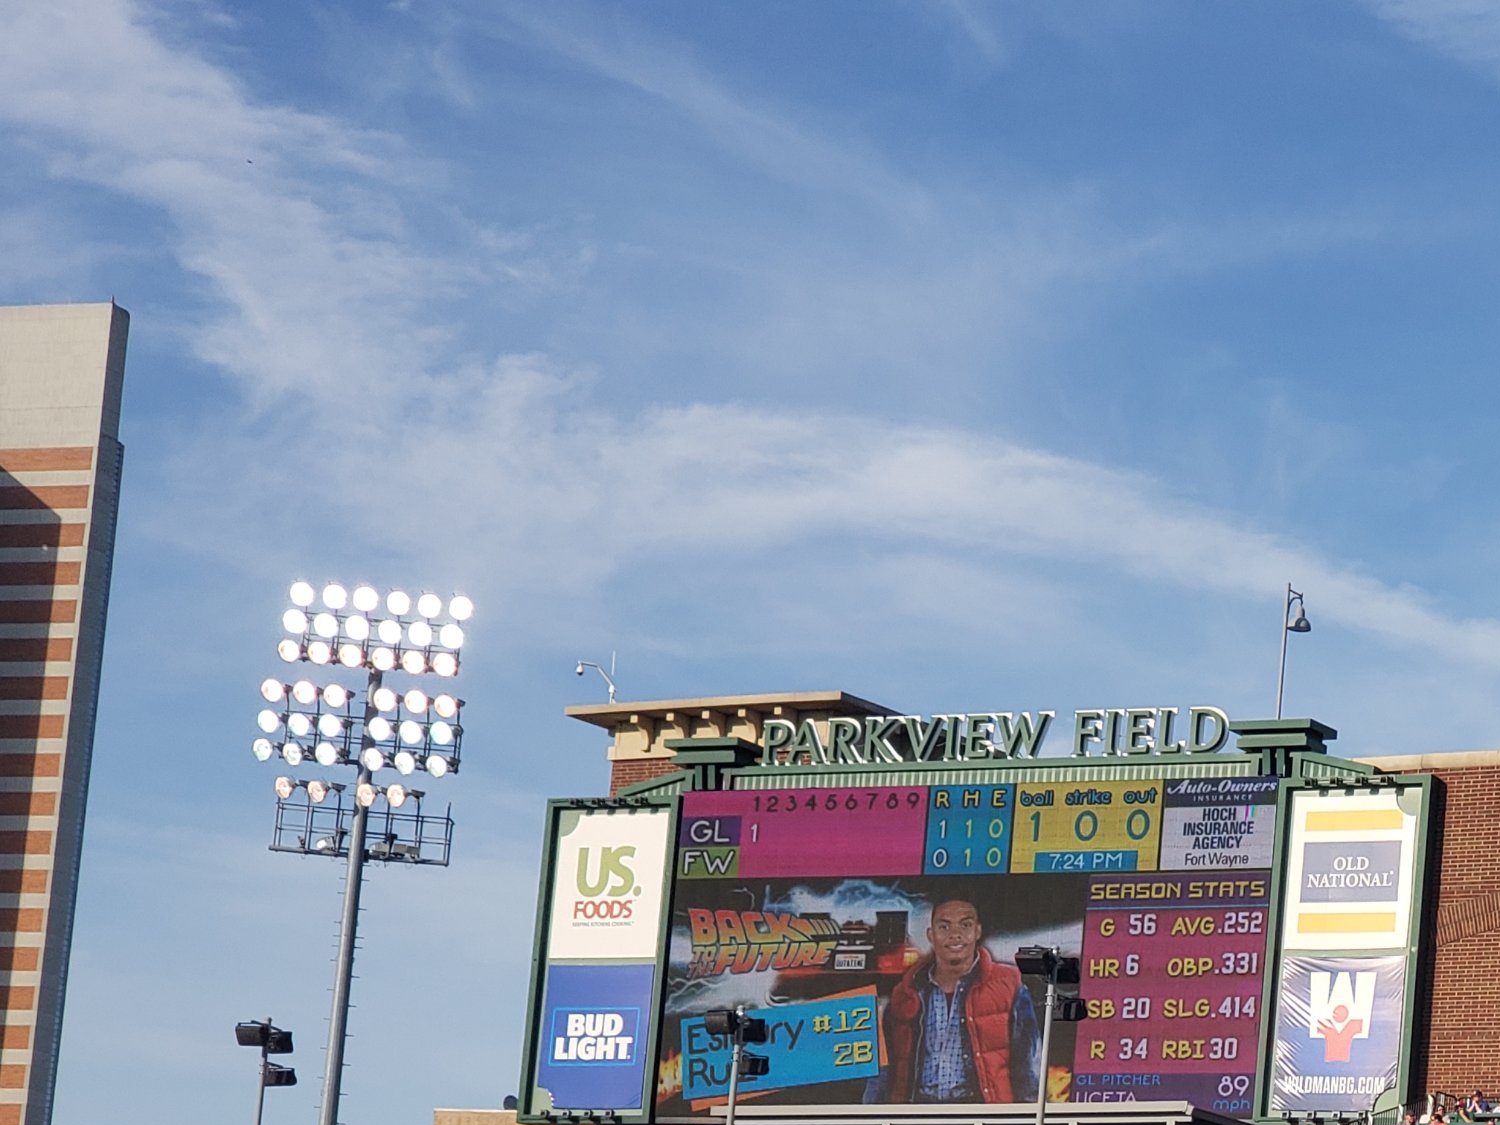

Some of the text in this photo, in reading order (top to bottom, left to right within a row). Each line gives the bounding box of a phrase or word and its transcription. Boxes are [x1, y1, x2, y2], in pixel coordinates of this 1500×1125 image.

[761, 705, 1230, 767] PARKVIEW FIELD
[1020, 787, 1158, 806] ball strike out
[1167, 778, 1277, 796] Auto-Owners
[936, 789, 1007, 808] R H E
[1030, 808, 1151, 842] 1 0 0
[1202, 807, 1237, 822] HOCH
[690, 819, 758, 844] GL 1
[939, 818, 947, 840] 1
[965, 818, 973, 839] 1
[1183, 821, 1254, 836] INSURANCE
[1192, 834, 1243, 850] AGENCY
[683, 850, 735, 875] FW
[964, 847, 972, 867] 1
[1050, 851, 1123, 870] 7:24 PM
[1185, 852, 1249, 868] Fort Wayne
[1332, 856, 1369, 871] OLD
[1090, 880, 1266, 900] SEASON STATS
[1306, 873, 1392, 889] NATIONAL
[573, 899, 633, 920] FOODS
[688, 907, 815, 944] BACK
[1099, 911, 1263, 937] G 56 AVG .252
[713, 941, 837, 976] FUTURE
[1089, 952, 1258, 978] HR 6 OBP .331
[1087, 996, 1256, 1019] SB 20 SLG .414
[567, 1013, 624, 1038] BUD
[812, 1007, 872, 1034] #12
[554, 1036, 634, 1061] LIGHT
[833, 1040, 874, 1067] 2B
[1090, 1037, 1238, 1060] R 34 RBI 30
[1076, 1073, 1161, 1087] GL PITCHER
[1217, 1075, 1249, 1097] 89
[1212, 1098, 1251, 1112] mph
